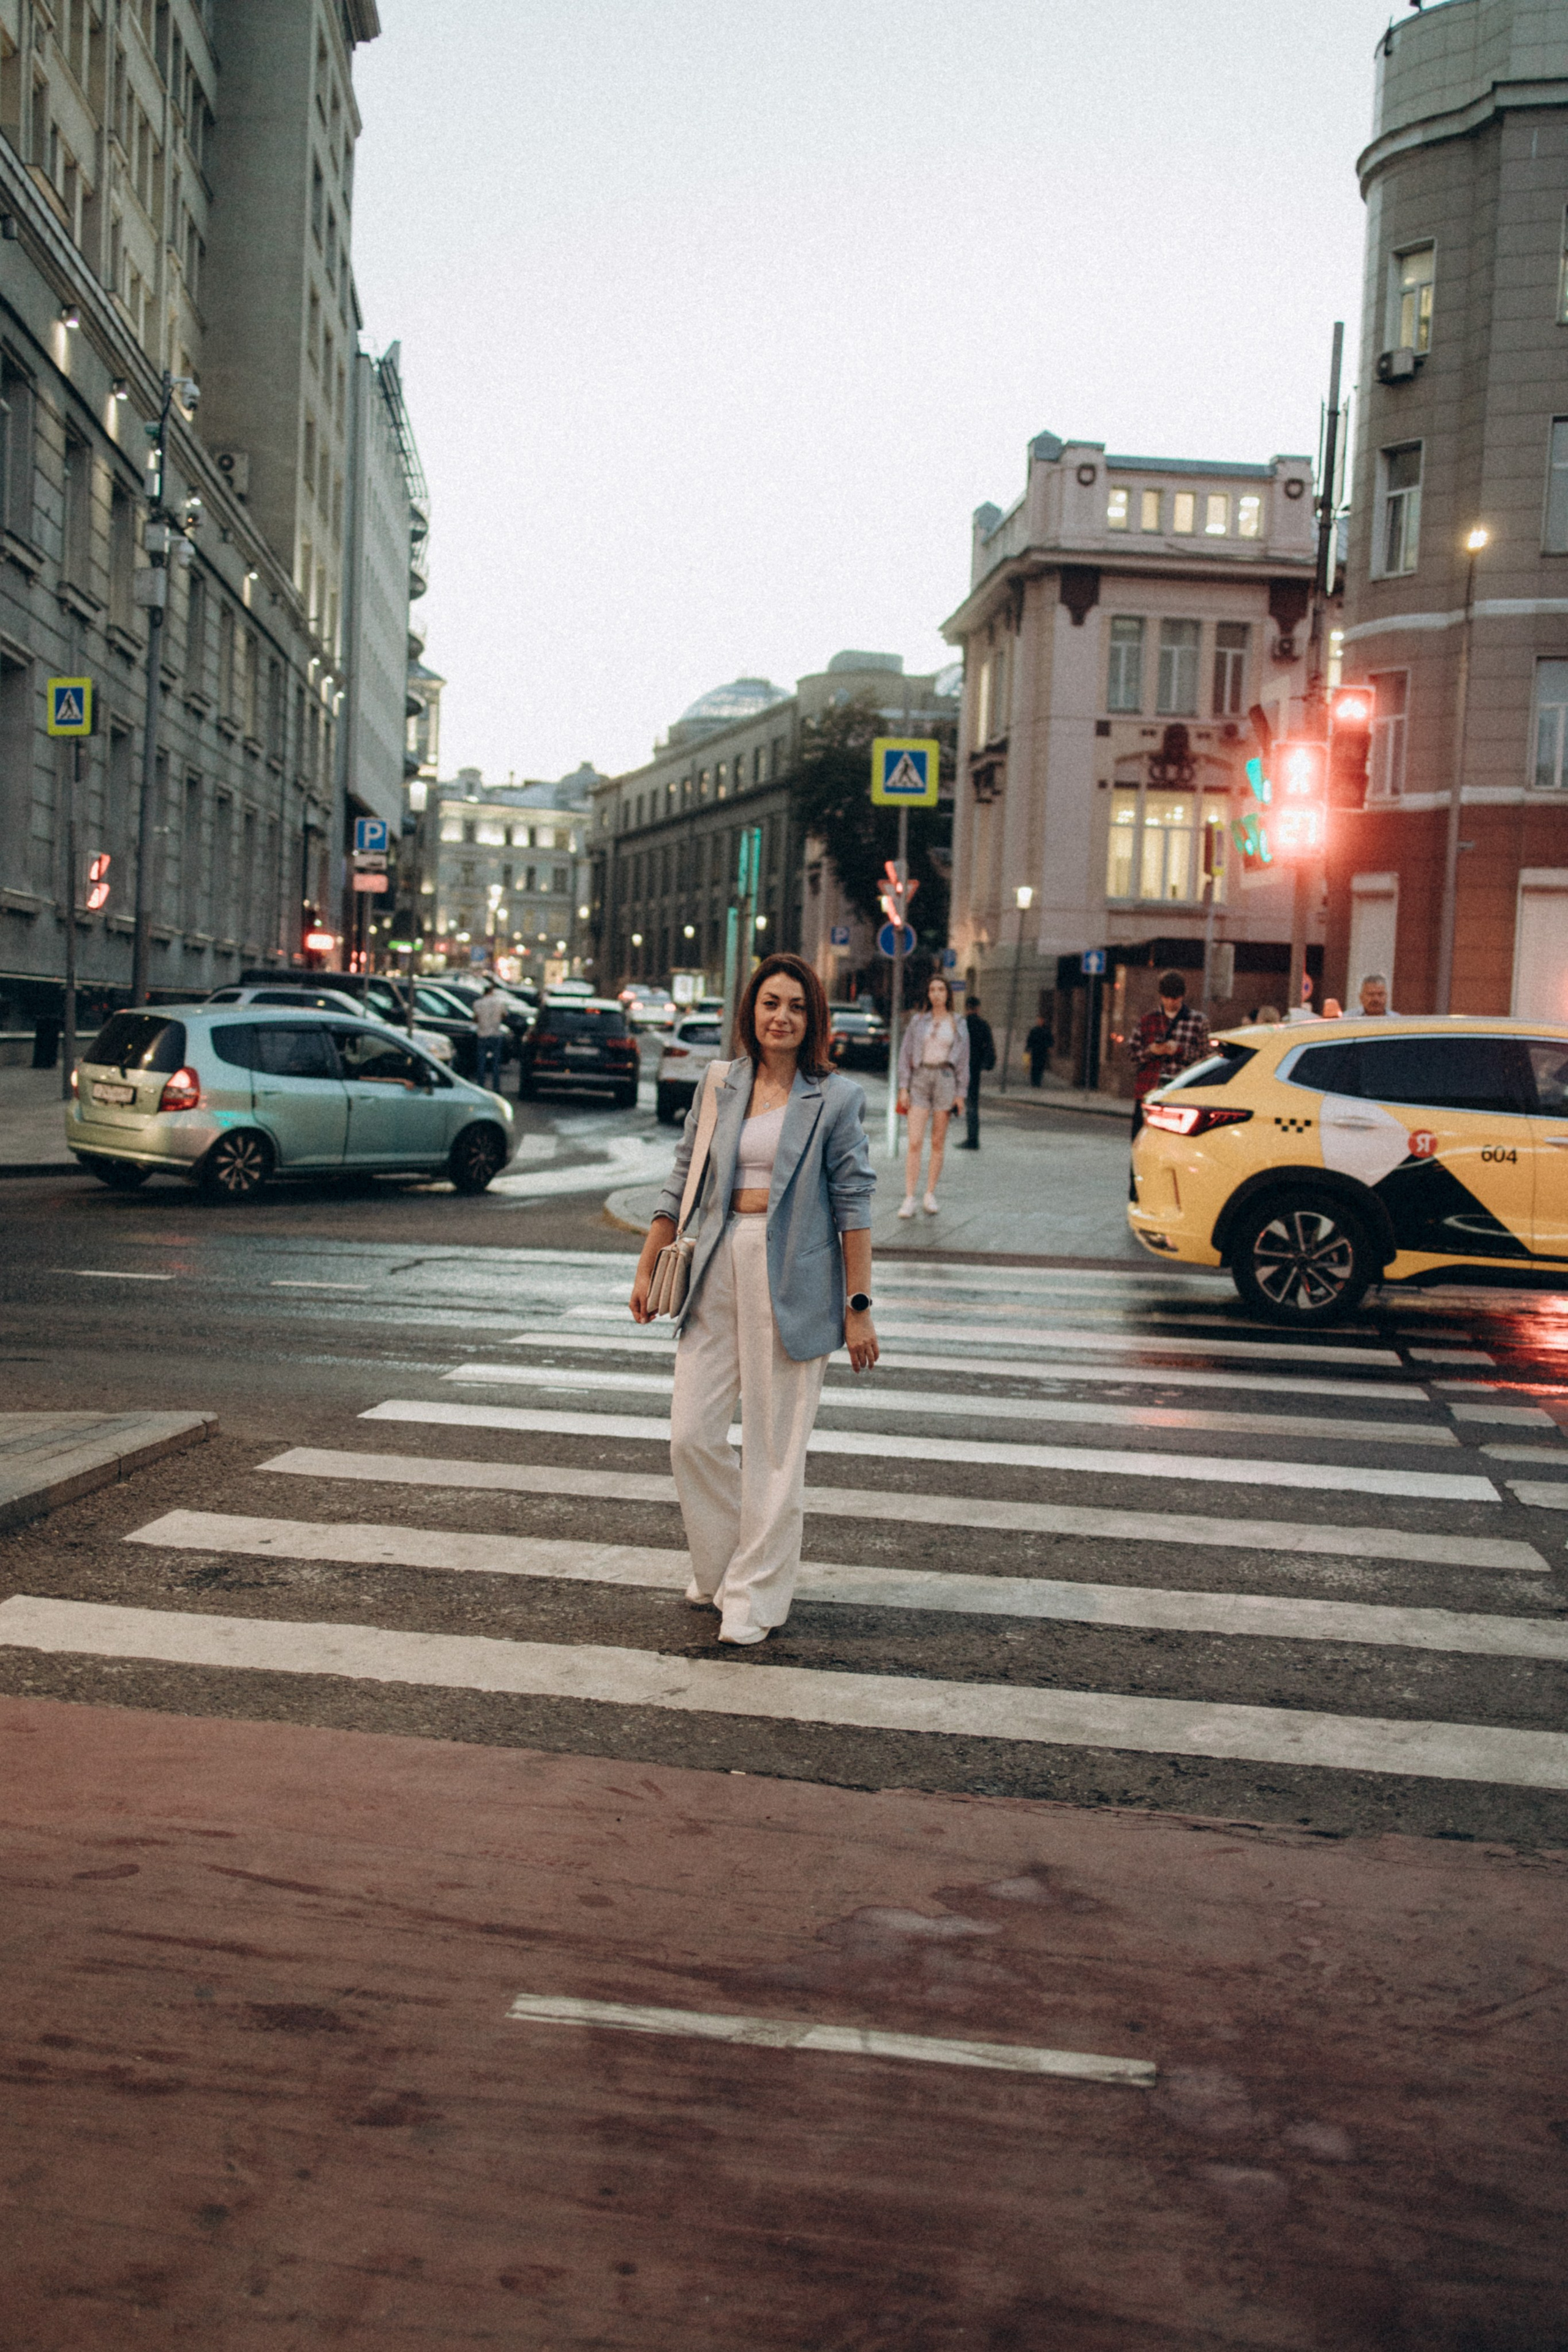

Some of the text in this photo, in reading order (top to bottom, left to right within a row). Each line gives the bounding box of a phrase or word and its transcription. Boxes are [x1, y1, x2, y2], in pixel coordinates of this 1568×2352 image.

[364, 822, 383, 848] P
[1280, 810, 1317, 843] 27
[834, 927, 848, 944] P
[1416, 1134, 1431, 1153] Я
[1481, 1144, 1517, 1164] 604
